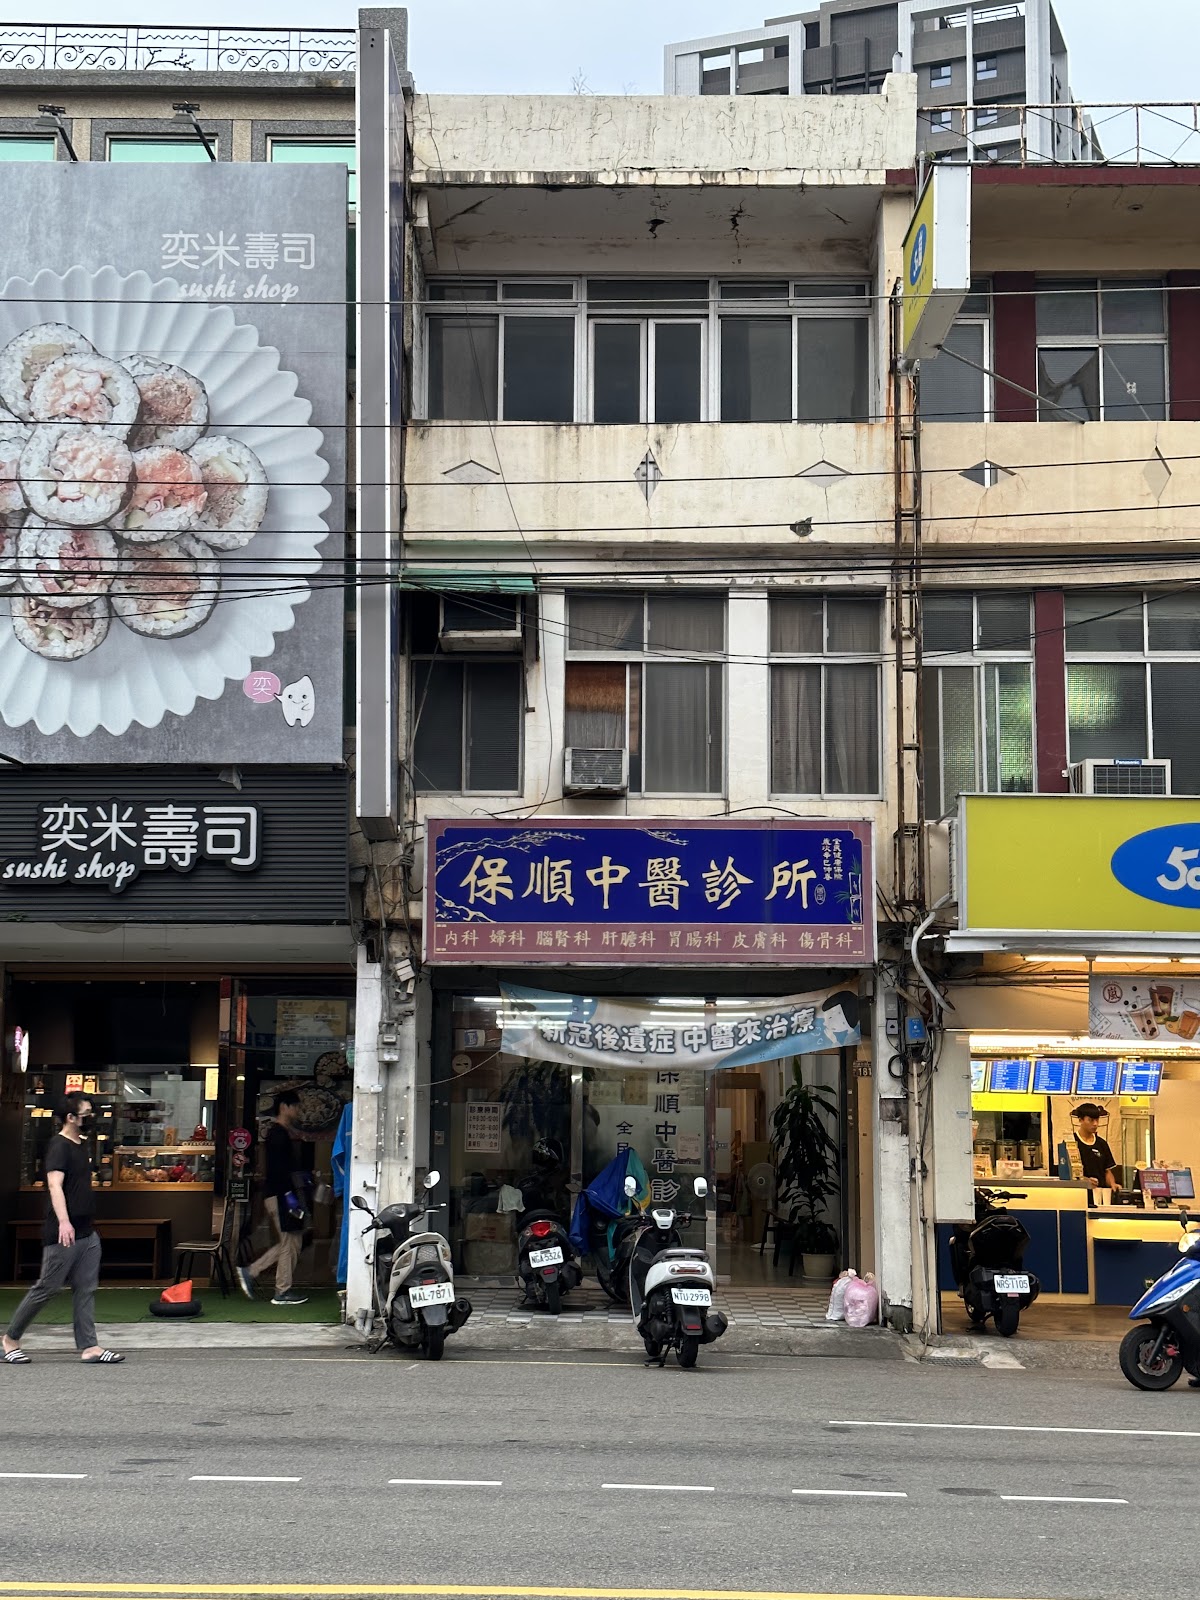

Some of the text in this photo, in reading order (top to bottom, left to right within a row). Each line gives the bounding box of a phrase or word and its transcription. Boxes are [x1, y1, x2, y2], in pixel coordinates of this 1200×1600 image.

[161, 230, 316, 270] 奕米壽司
[178, 273, 299, 307] sushi shop
[251, 676, 273, 696] 奕
[40, 802, 258, 868] 奕米壽司
[2, 852, 136, 887] sushi shop
[459, 854, 817, 910] 保順中醫診所
[489, 930, 526, 947] 婦科
[668, 930, 722, 949] 胃腸科
[732, 930, 788, 949] 皮膚科
[798, 930, 854, 949] 傷骨科
[540, 1006, 816, 1054] 新冠後遺症 中醫來治療
[858, 1067, 872, 1077] 181
[652, 1071, 681, 1212] 保順中醫診
[411, 1287, 452, 1304] MAL-7871
[674, 1291, 710, 1302] NTU-2998
[996, 1278, 1029, 1290] NRS-1105
